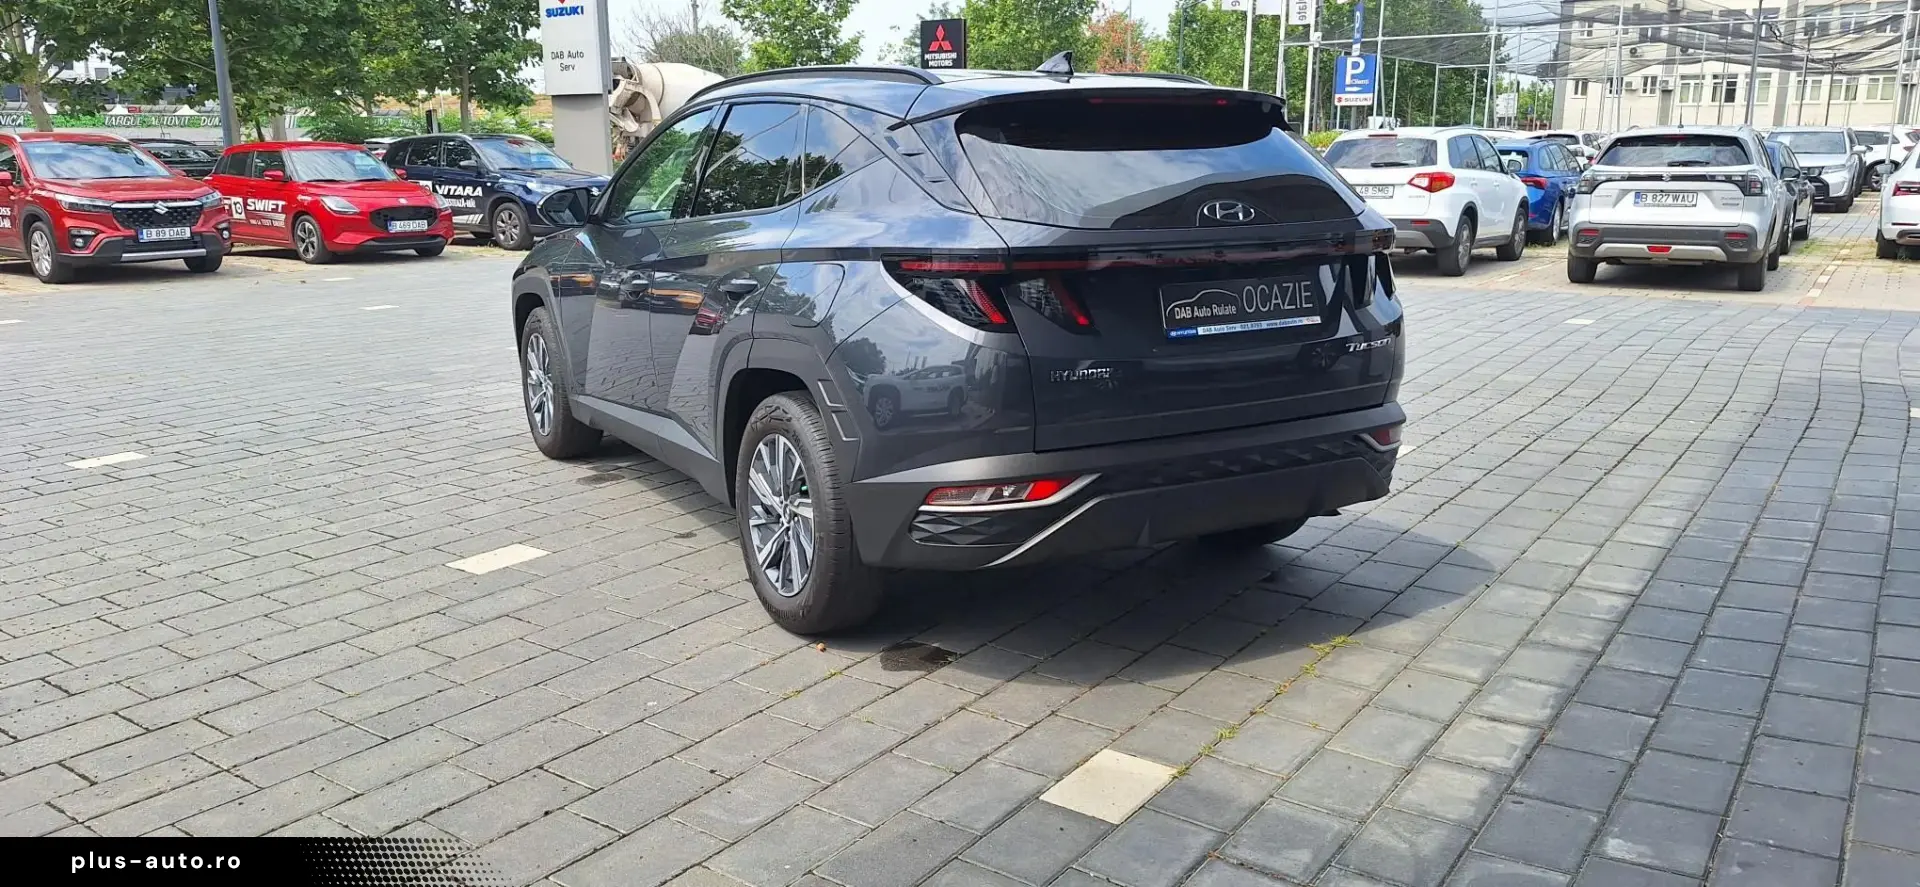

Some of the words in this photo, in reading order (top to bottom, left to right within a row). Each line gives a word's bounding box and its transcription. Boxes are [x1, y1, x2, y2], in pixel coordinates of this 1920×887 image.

[545, 6, 584, 18] SUZUKI
[551, 51, 565, 60] DAB
[567, 50, 584, 59] Auto
[924, 52, 957, 60] MITSUBISHI
[560, 62, 576, 72] Serv
[1345, 57, 1365, 85] P
[149, 115, 190, 126] AUTOVIT
[435, 184, 483, 196] VITARA
[1371, 186, 1389, 195] SMG
[1641, 193, 1648, 202] B
[1651, 193, 1670, 203] 827
[1671, 193, 1695, 203] WAU
[246, 199, 286, 212] SWIFT
[146, 230, 153, 238] B
[155, 230, 167, 238] 89
[168, 228, 187, 237] DAB
[1242, 281, 1314, 313] OCAZIE
[1174, 306, 1192, 319] DAB
[1193, 304, 1212, 318] Auto
[1212, 304, 1237, 317] Rulate
